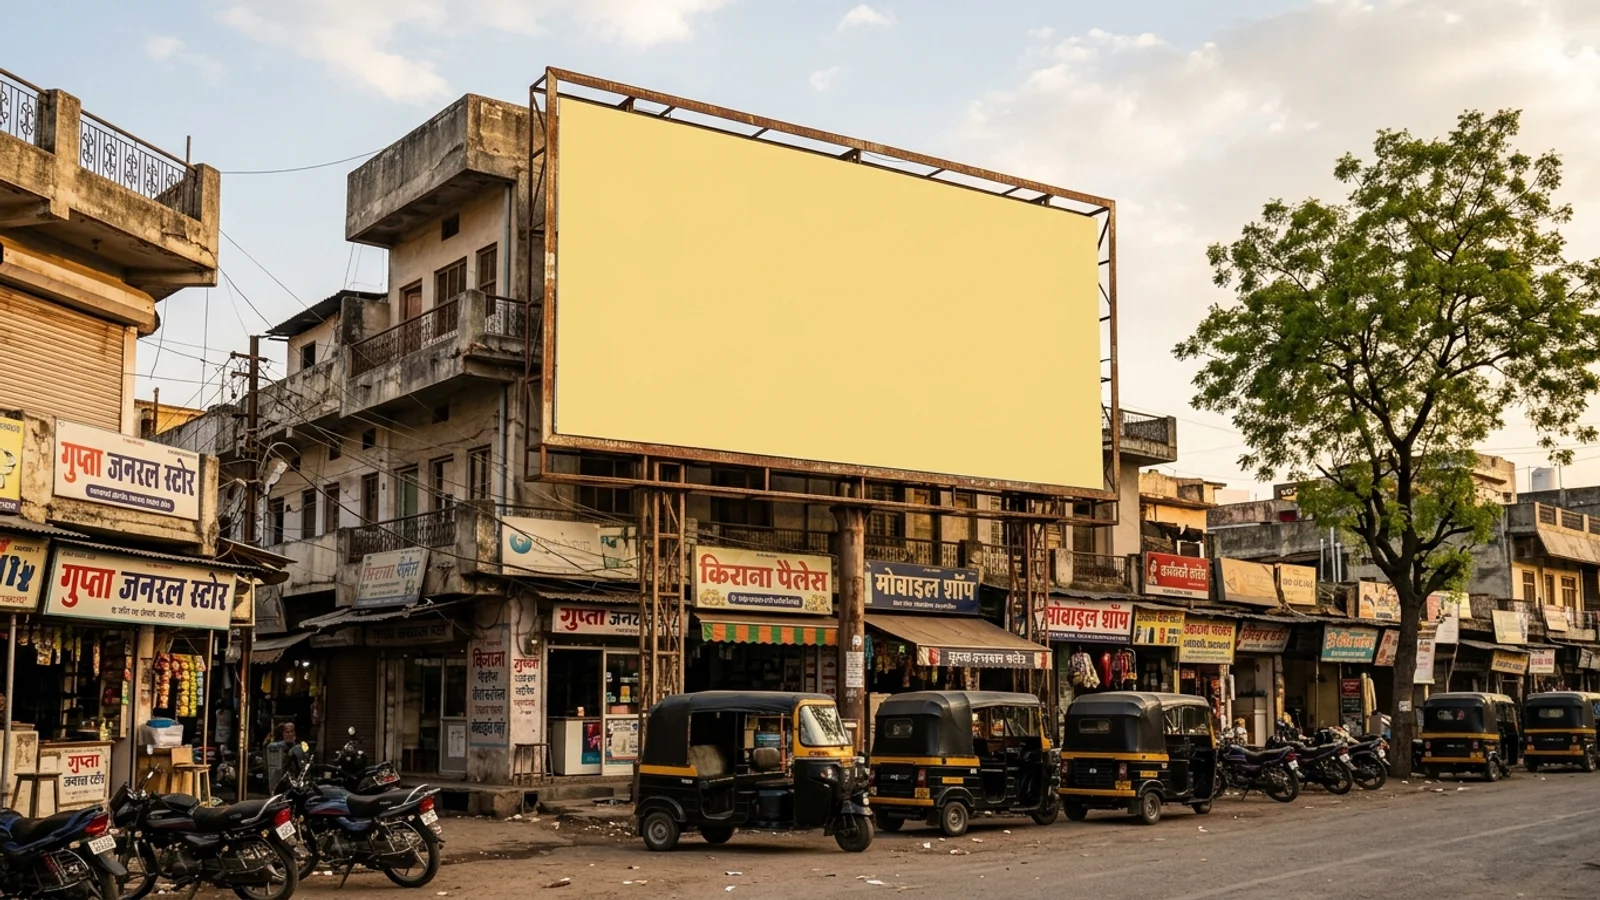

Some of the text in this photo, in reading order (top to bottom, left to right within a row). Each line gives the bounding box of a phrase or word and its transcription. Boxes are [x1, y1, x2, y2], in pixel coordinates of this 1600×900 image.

[61, 441, 196, 496] गुप्ता जनरल स्टोर
[61, 563, 116, 608] गुप्ता
[119, 571, 187, 607] जनरल
[190, 572, 230, 611] स्टोर
[699, 553, 828, 591] किराना पैलेस
[560, 607, 606, 631] गुप्ता
[68, 755, 100, 774] गुप्ता
